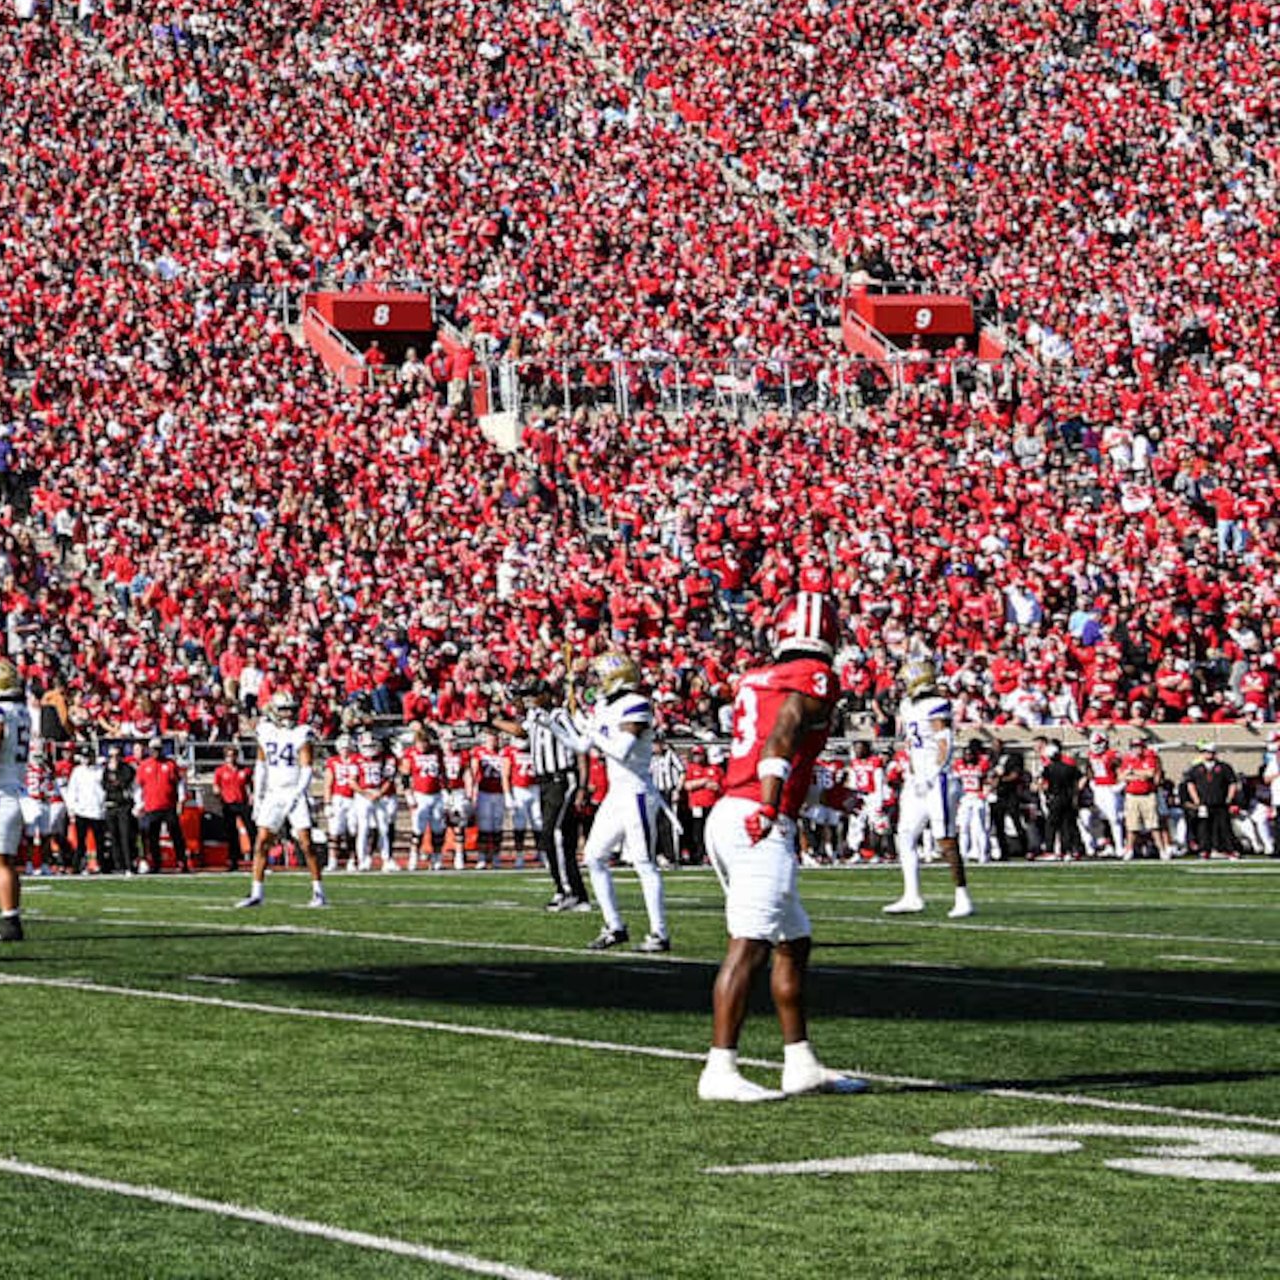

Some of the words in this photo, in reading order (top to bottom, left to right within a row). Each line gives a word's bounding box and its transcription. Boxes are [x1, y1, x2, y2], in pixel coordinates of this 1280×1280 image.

[373, 304, 390, 325] 8
[915, 308, 933, 329] 9
[812, 671, 828, 696] 3
[731, 686, 759, 759] 3
[908, 721, 924, 749] 3
[264, 742, 297, 767] 24
